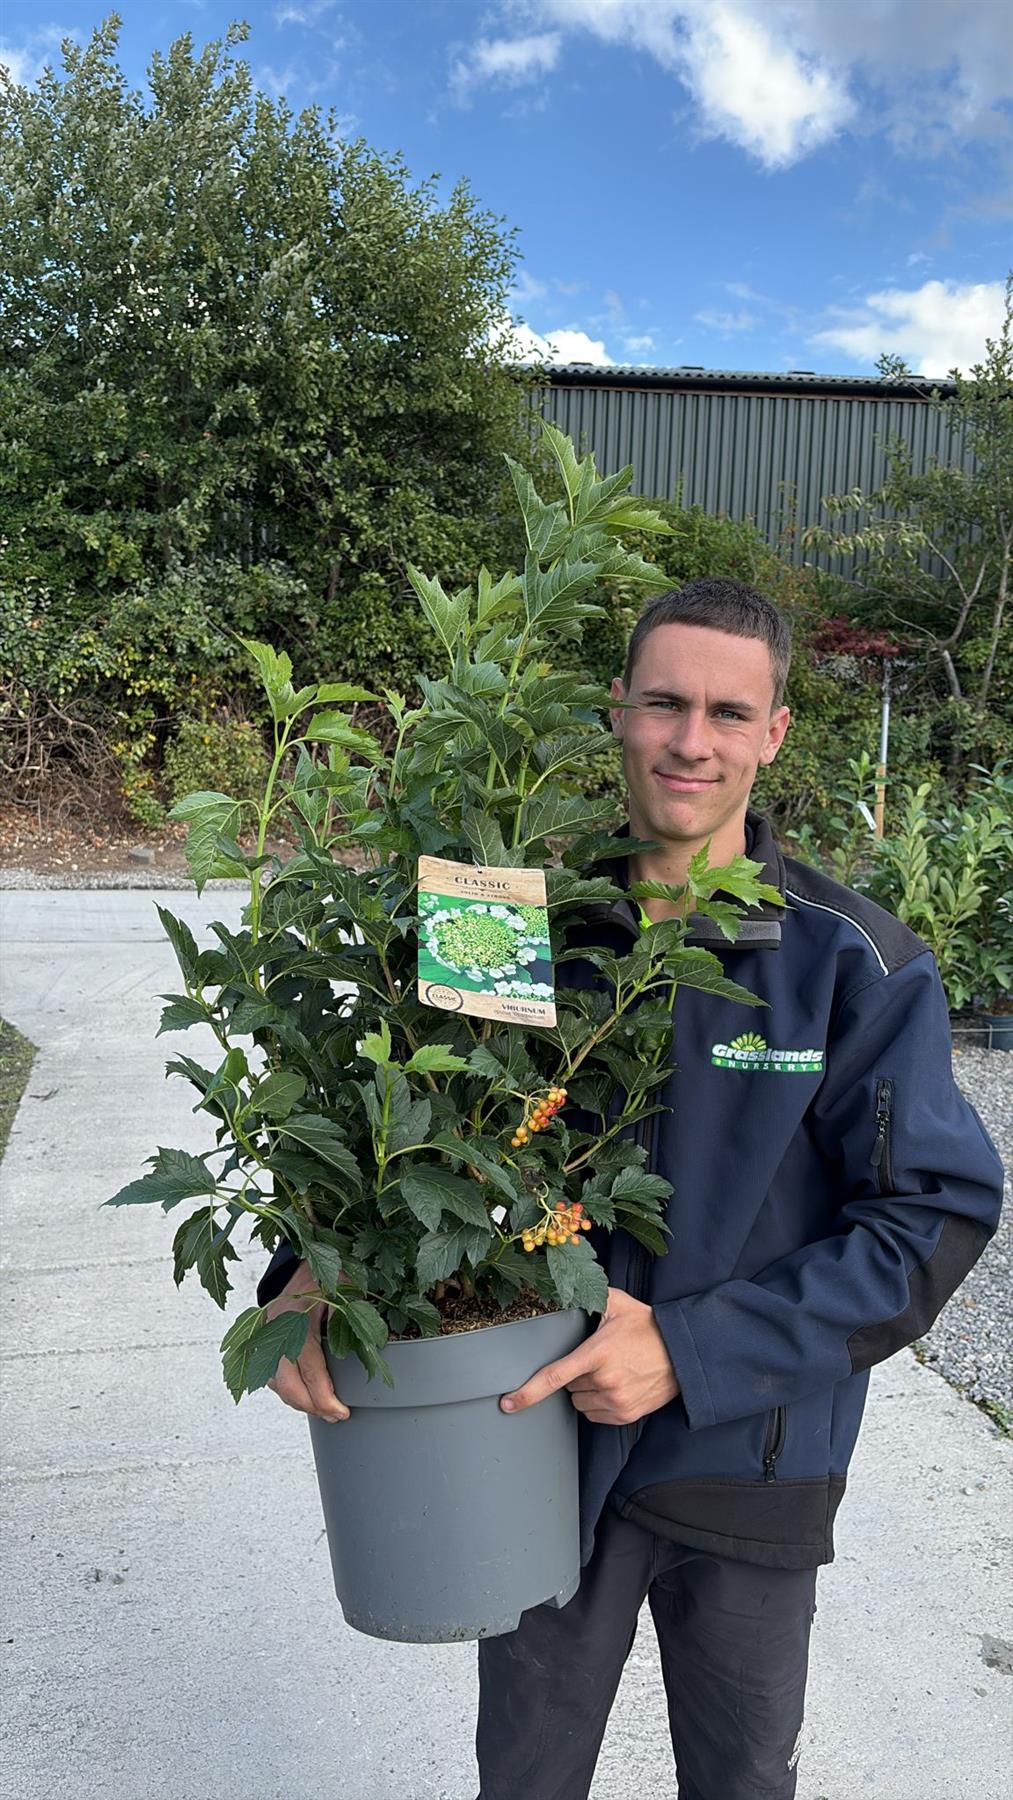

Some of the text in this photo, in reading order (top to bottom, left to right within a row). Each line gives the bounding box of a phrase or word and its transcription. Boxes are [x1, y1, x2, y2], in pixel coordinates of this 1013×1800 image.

[454, 876, 510, 890] CLASSIC
[502, 1004, 546, 1016] VIBURNUM
[712, 1044, 824, 1062] Grasslands
[728, 1060, 808, 1071] NURSERY
